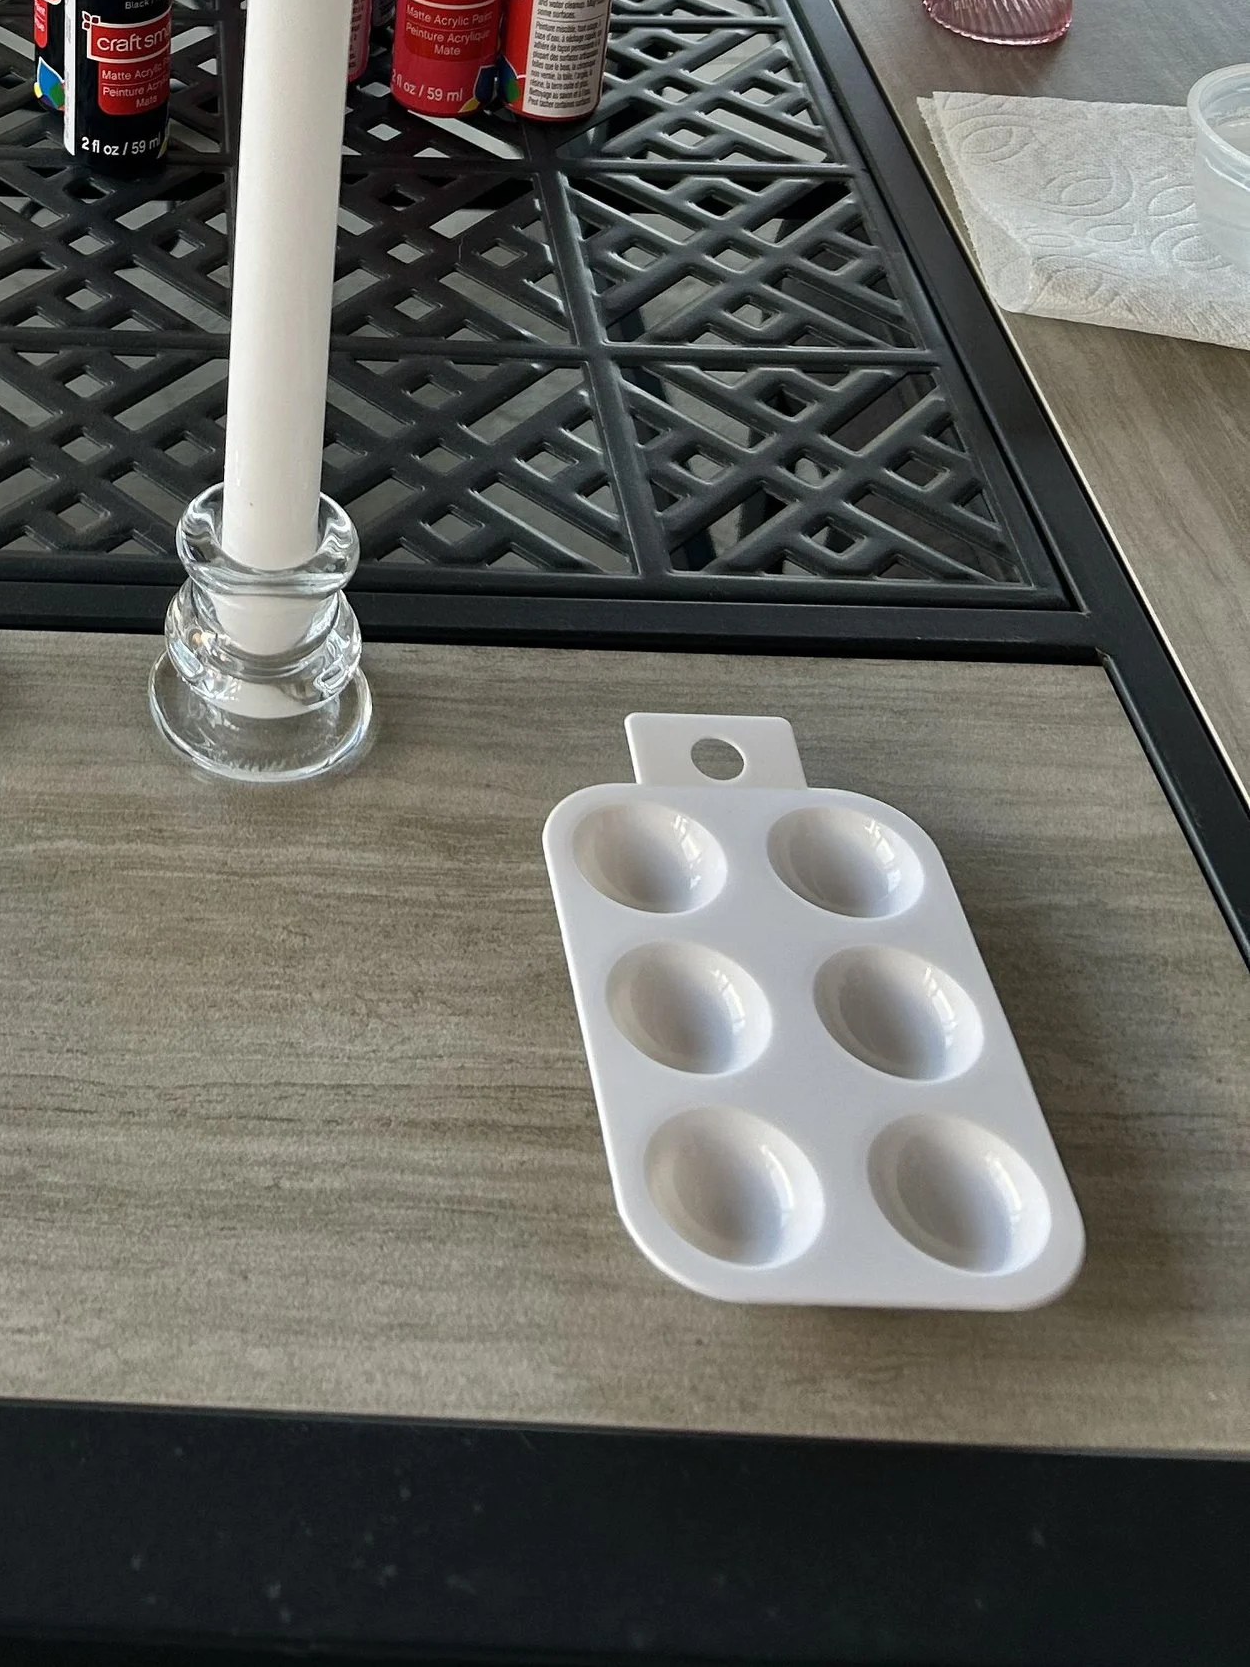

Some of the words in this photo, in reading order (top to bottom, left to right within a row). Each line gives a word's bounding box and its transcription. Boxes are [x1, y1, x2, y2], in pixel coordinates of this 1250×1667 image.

[406, 4, 432, 22] Matte
[434, 13, 470, 29] Acrylic
[406, 22, 444, 43] Peinture
[447, 30, 491, 45] Acrylique
[96, 34, 142, 52] craft
[434, 45, 461, 56] Mate
[101, 70, 132, 81] Matte
[102, 86, 145, 97] Peinture
[403, 84, 417, 95] oz
[426, 87, 443, 100] 59
[446, 88, 463, 102] ml
[136, 96, 158, 108] Mate
[81, 136, 90, 151] 2
[92, 138, 100, 154] fl
[103, 143, 120, 157] oz
[131, 140, 146, 155] 59
